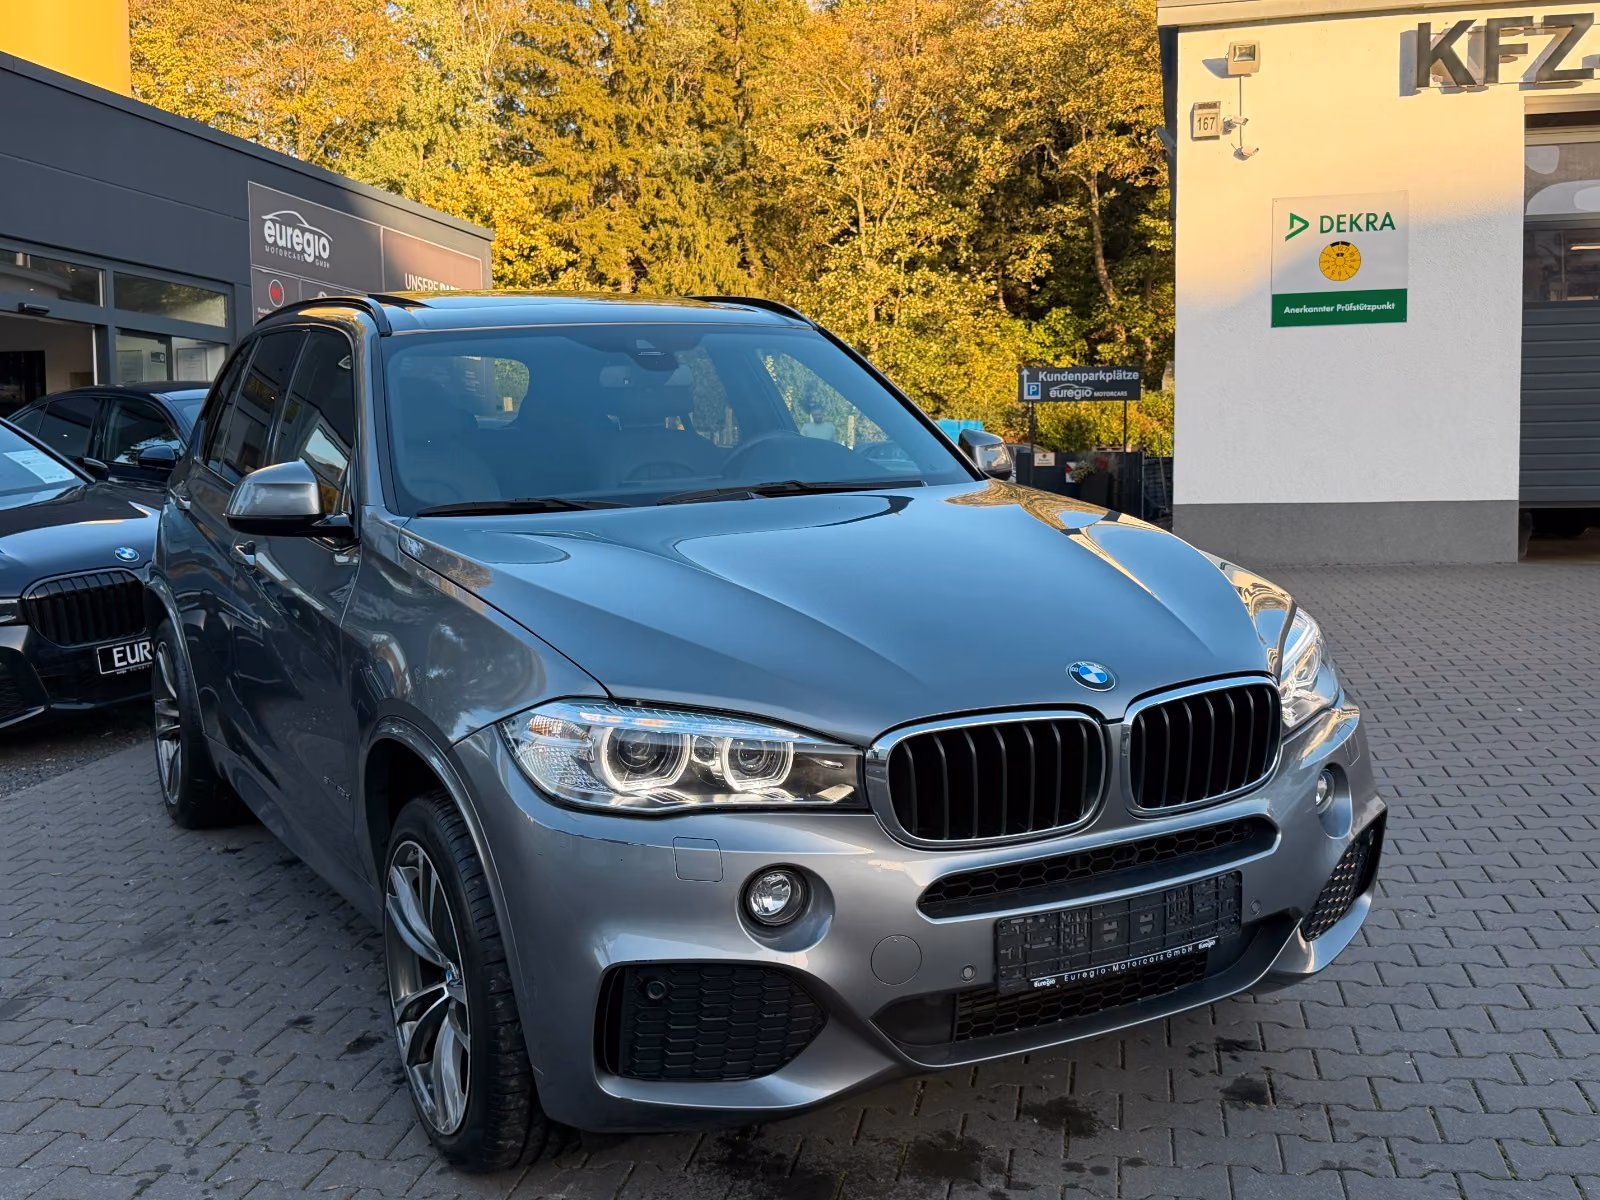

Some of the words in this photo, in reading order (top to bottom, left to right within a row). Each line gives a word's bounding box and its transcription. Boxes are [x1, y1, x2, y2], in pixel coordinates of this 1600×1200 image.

[1416, 12, 1595, 89] KFZ
[1197, 116, 1216, 132] 167
[1318, 211, 1397, 235] DEKRA
[263, 220, 330, 263] euregio
[1283, 305, 1335, 314] Anerkannter
[1336, 302, 1396, 313] Prüfstützpunkt
[1038, 370, 1140, 383] Kundenparkplätze
[1029, 385, 1037, 395] P
[1049, 388, 1092, 399] euregio
[112, 641, 154, 667] EUR
[1166, 946, 1193, 959] GmbH
